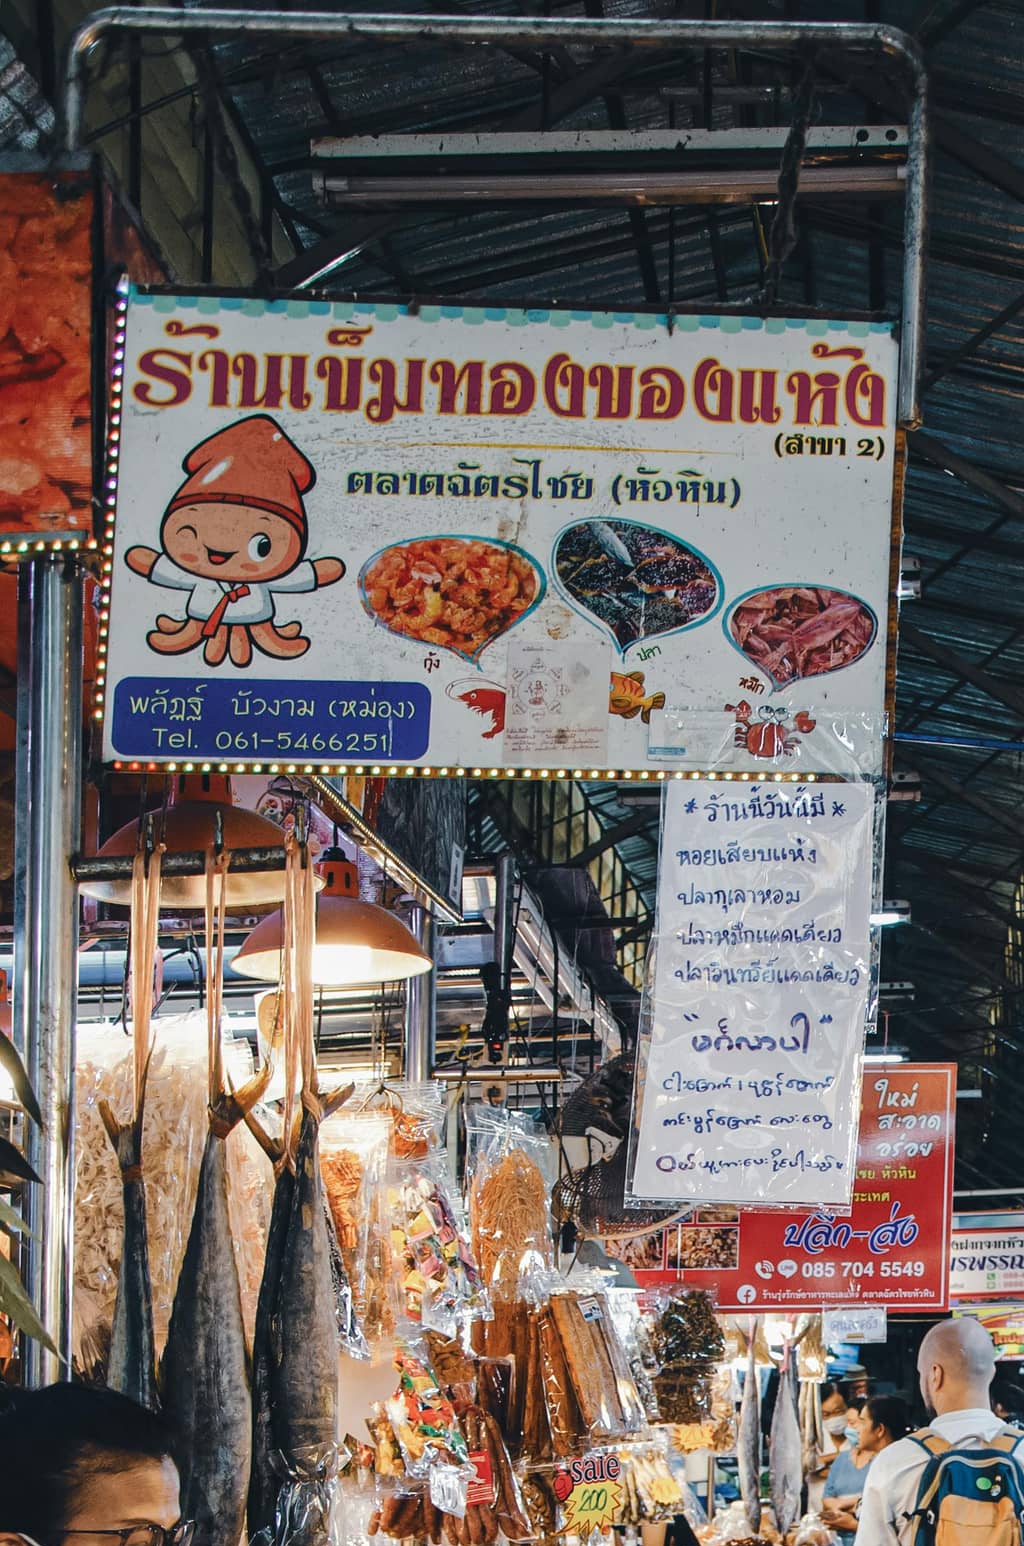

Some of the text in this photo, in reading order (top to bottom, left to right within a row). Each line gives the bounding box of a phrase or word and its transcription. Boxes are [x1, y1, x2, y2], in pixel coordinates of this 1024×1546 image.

[130, 321, 888, 427] ร้านเข็มทองของแห้ง
[773, 433, 886, 460] (สาขา 2)
[346, 458, 742, 508] ตลาดฉัตรไชย (หัวหิน)
[423, 652, 441, 673] กุ้ง
[636, 645, 662, 662] ปลา
[738, 675, 766, 696] หมึก
[231, 690, 315, 718] บัวงาม
[328, 688, 416, 719] (หม่อง)
[151, 728, 388, 752] Tel. 061-5466251
[874, 1078, 920, 1109] ใหม่
[878, 1113, 941, 1131] สะอาด
[876, 1132, 934, 1158] อร่อย
[881, 1164, 917, 1180] หัวหิน
[783, 1201, 919, 1254] ปลีก-ส่ง
[802, 1261, 836, 1278] 085
[840, 1261, 875, 1278] 704
[879, 1261, 925, 1278] 5549
[571, 1456, 620, 1482] sale
[578, 1489, 608, 1512] 200
